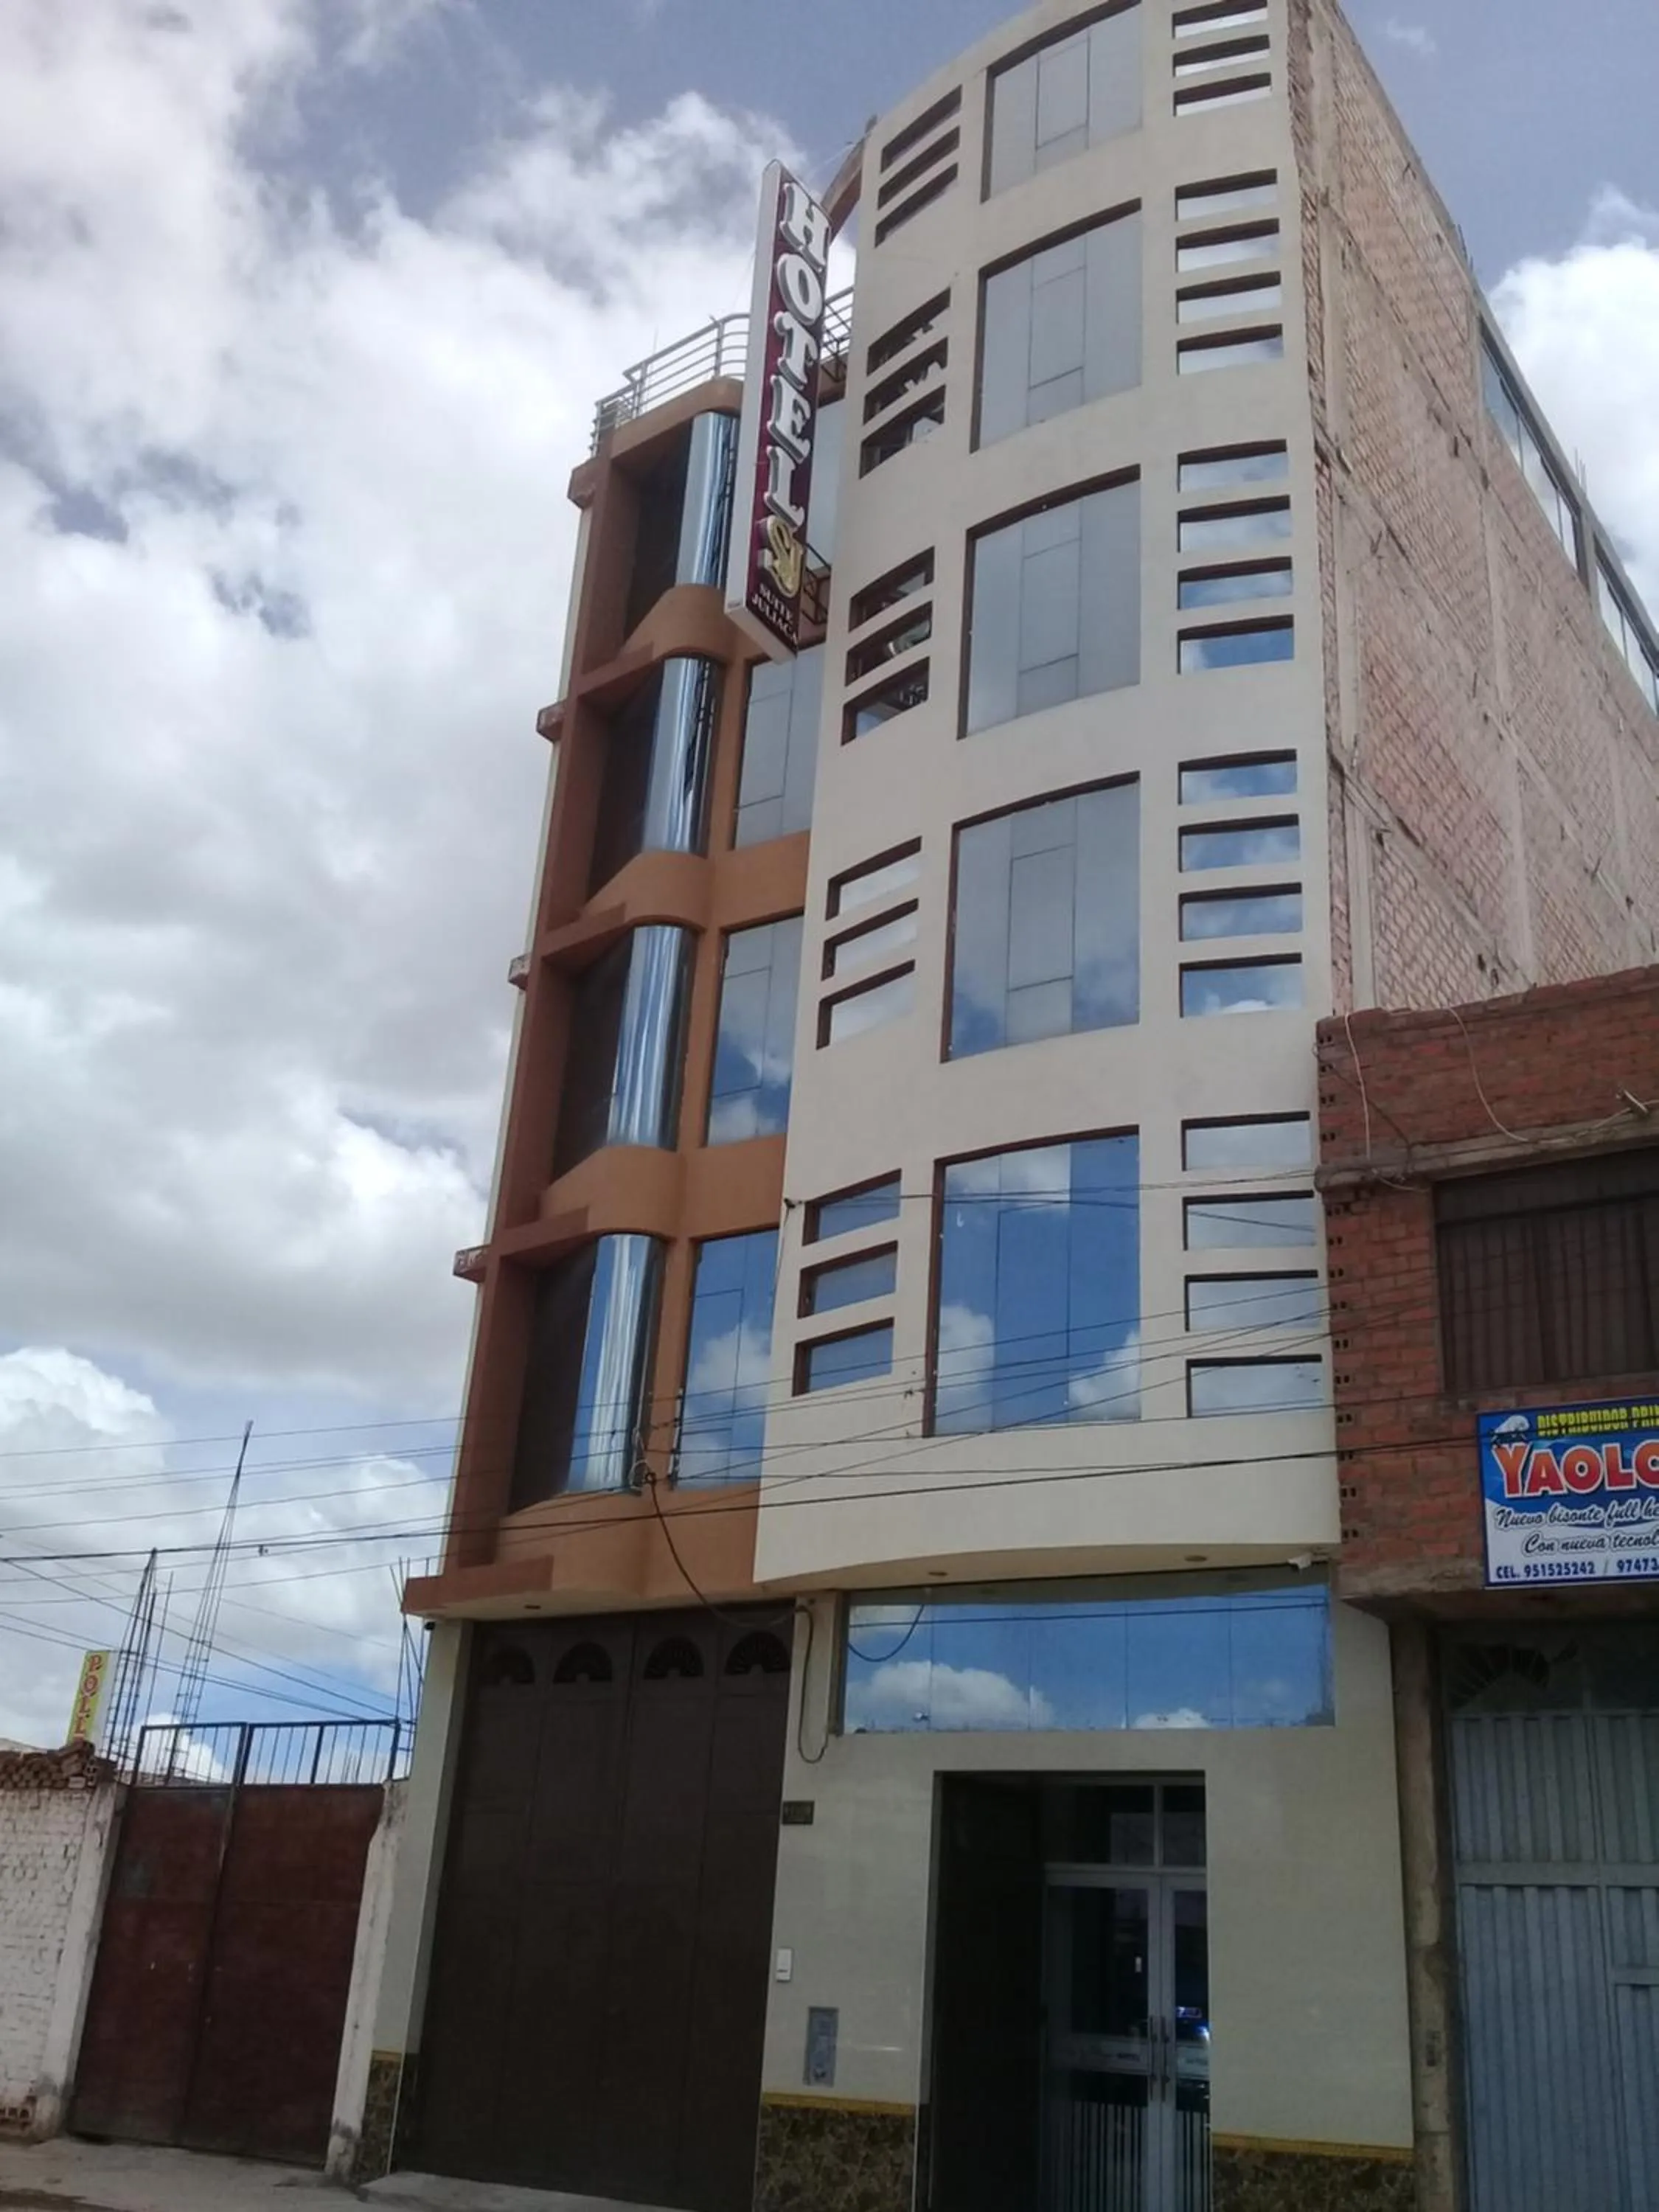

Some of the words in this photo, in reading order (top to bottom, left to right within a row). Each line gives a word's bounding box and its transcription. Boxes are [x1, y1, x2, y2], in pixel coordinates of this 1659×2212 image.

[765, 181, 832, 531] HOTEL
[1496, 1508, 1543, 1528] Nuevo
[1548, 1503, 1601, 1522] bisonte
[1606, 1500, 1639, 1527] full
[1524, 1533, 1555, 1554] Con
[1561, 1539, 1607, 1551] nueva
[1523, 1561, 1596, 1578] 951525242
